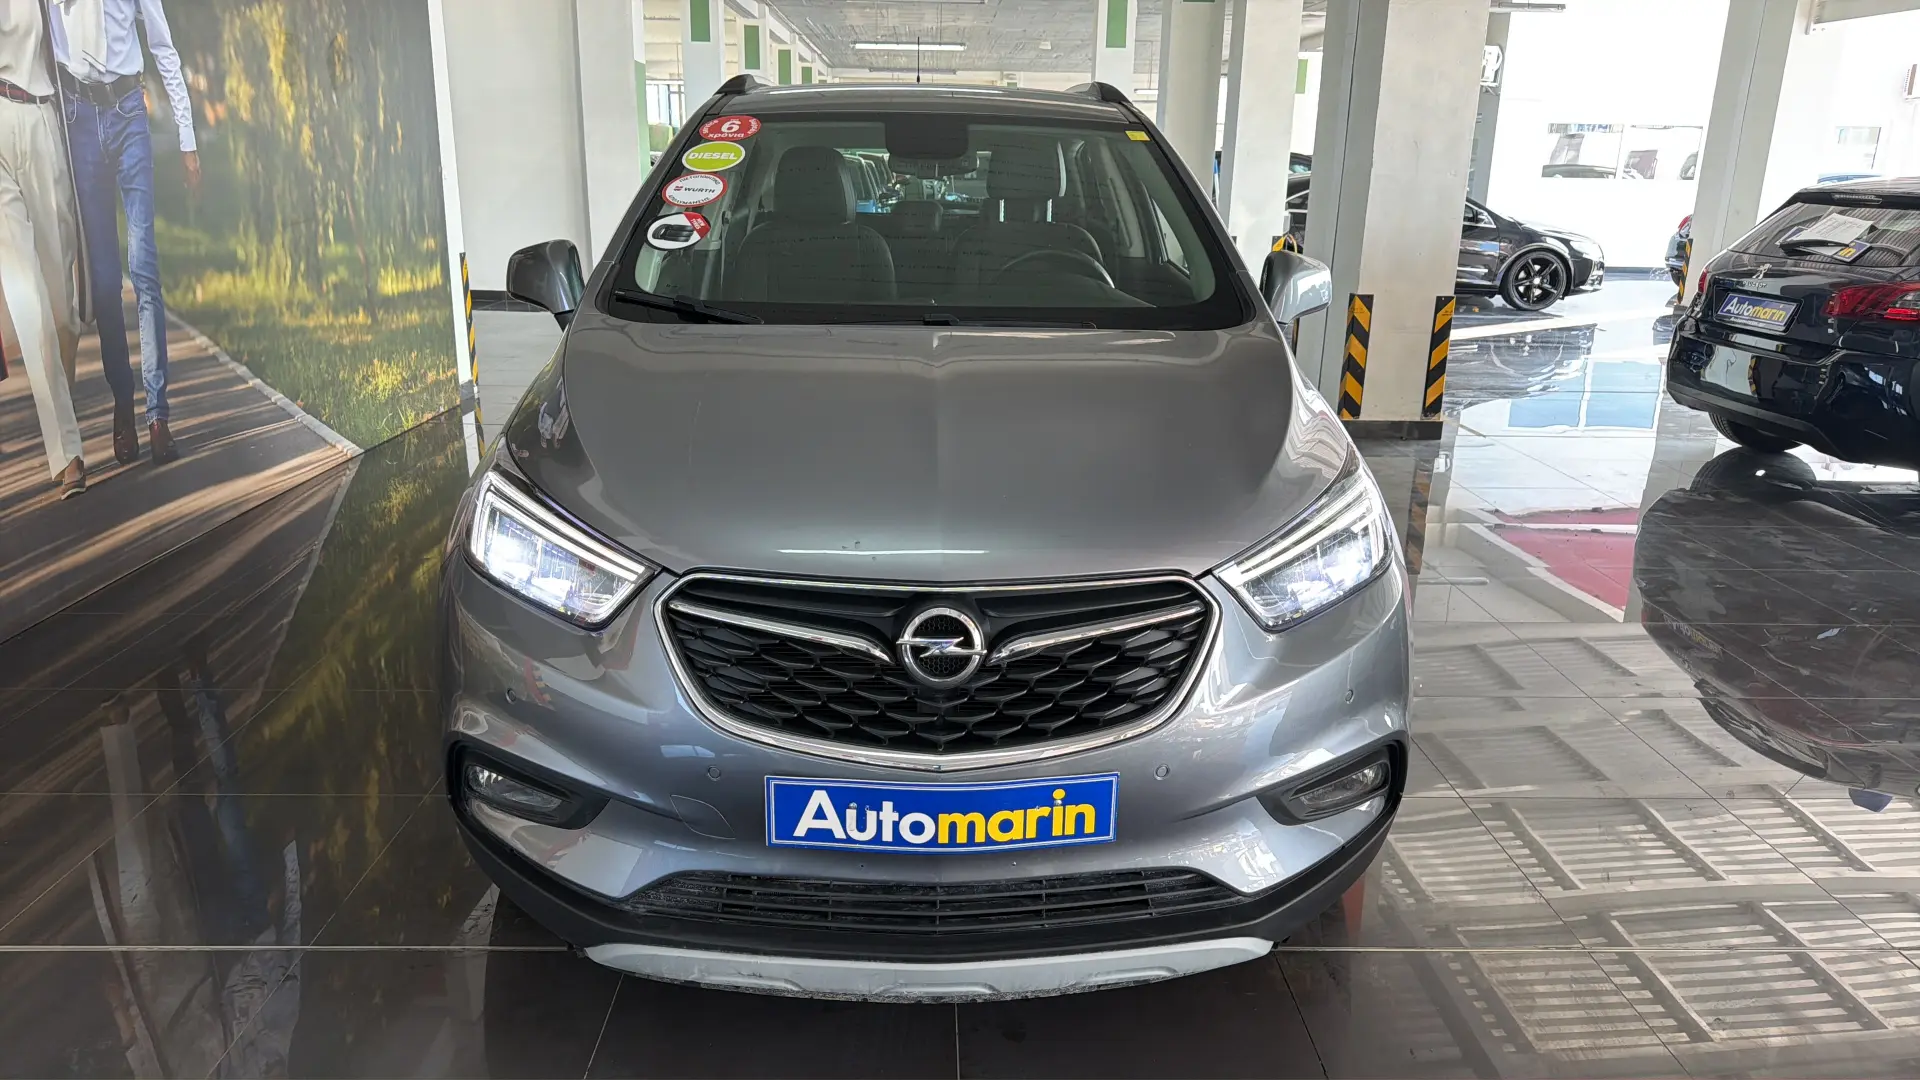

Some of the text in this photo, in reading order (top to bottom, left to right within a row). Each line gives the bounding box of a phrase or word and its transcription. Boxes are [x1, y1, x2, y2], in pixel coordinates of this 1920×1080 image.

[720, 120, 742, 133] 6
[689, 152, 738, 160] DIESEL
[1723, 297, 1786, 321] Automarin
[793, 788, 1096, 844] Automarin
